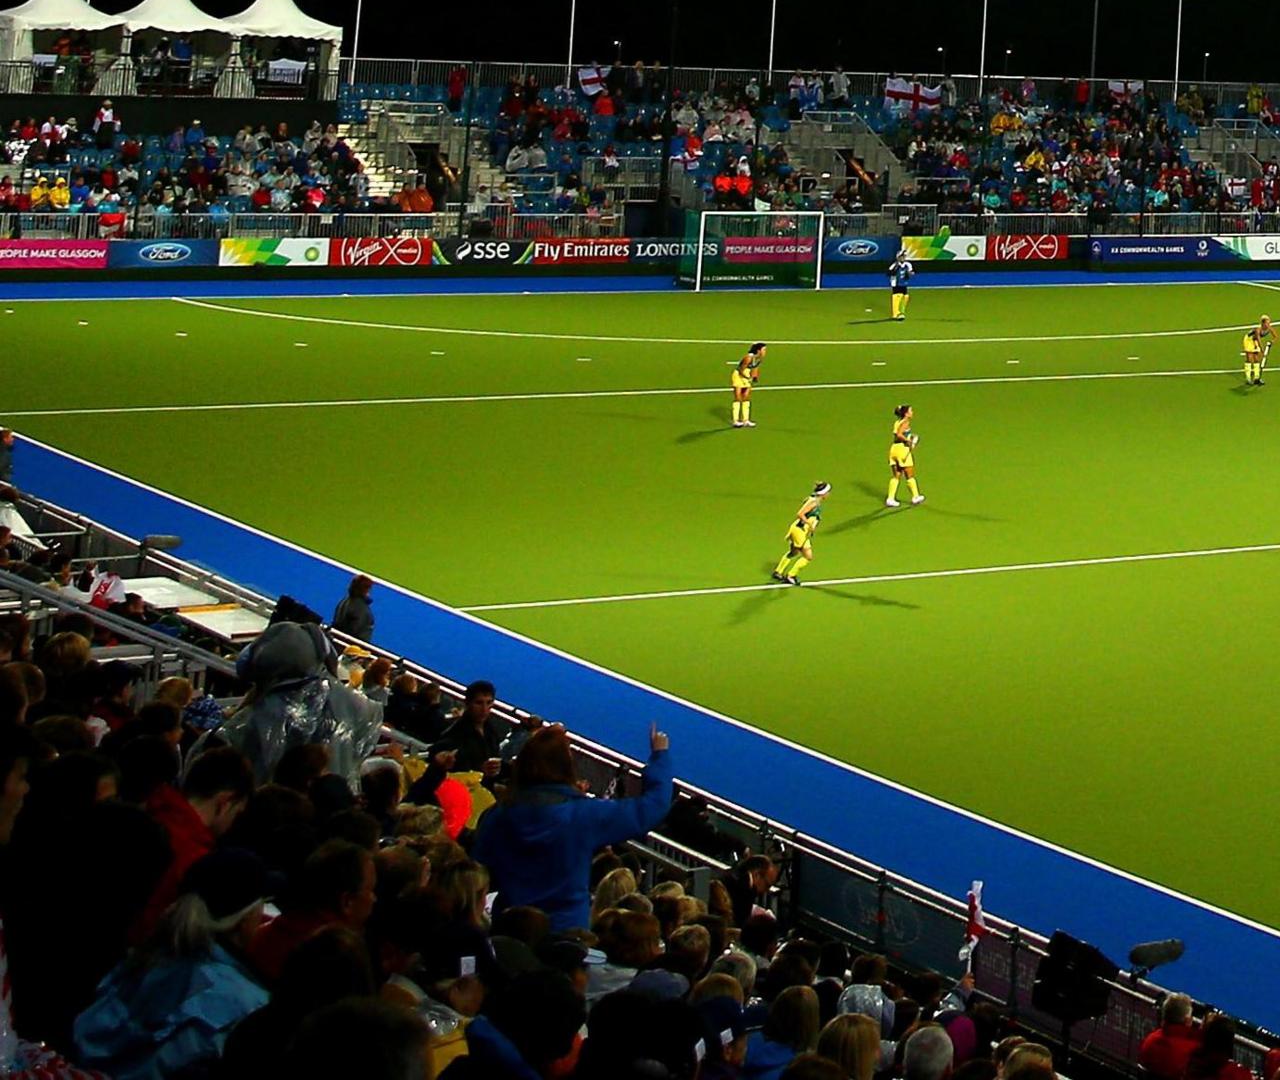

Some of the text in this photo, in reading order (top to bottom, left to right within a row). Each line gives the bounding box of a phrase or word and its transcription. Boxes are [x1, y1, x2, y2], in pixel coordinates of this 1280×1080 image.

[29, 248, 57, 258] MAKE
[58, 248, 106, 258] GLASGOW
[148, 245, 180, 260] Ford
[346, 238, 382, 265] Virgin
[473, 241, 510, 259] sse
[534, 240, 630, 261] Fly Emirates
[725, 245, 752, 254] PEOPLE
[754, 245, 775, 254] MAKE
[844, 242, 870, 256] Ford
[999, 235, 1027, 260] Virgin
